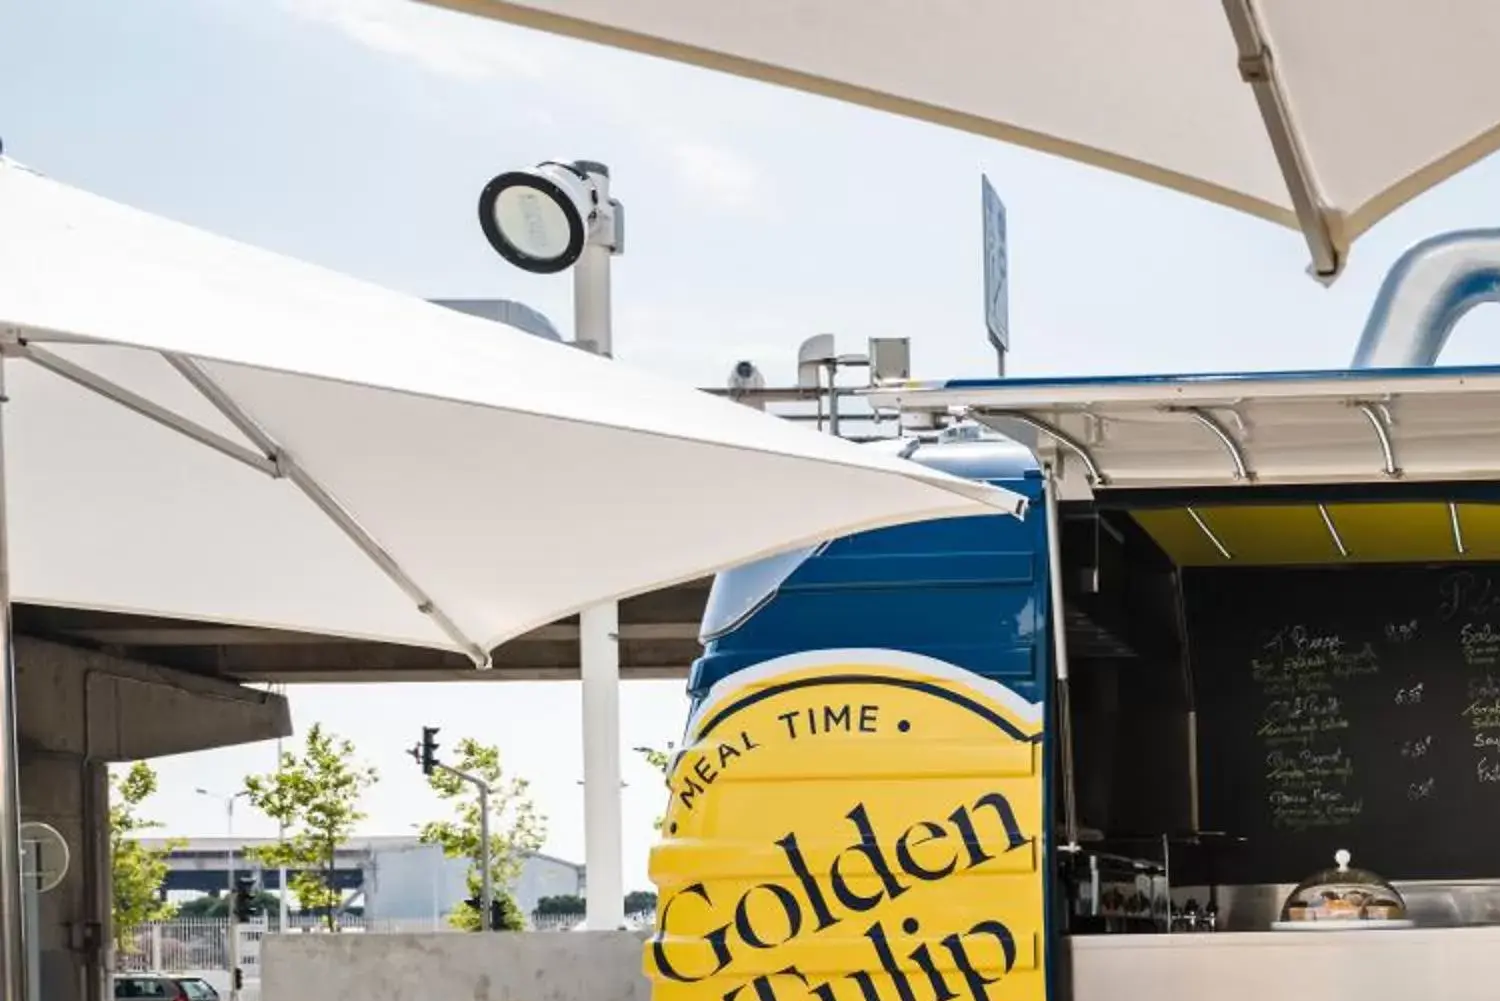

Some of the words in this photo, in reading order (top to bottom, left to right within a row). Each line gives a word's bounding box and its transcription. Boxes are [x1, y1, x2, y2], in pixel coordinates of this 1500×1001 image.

[679, 731, 760, 810] MEAL
[778, 705, 881, 739] TIME
[653, 791, 1034, 983] Golden
